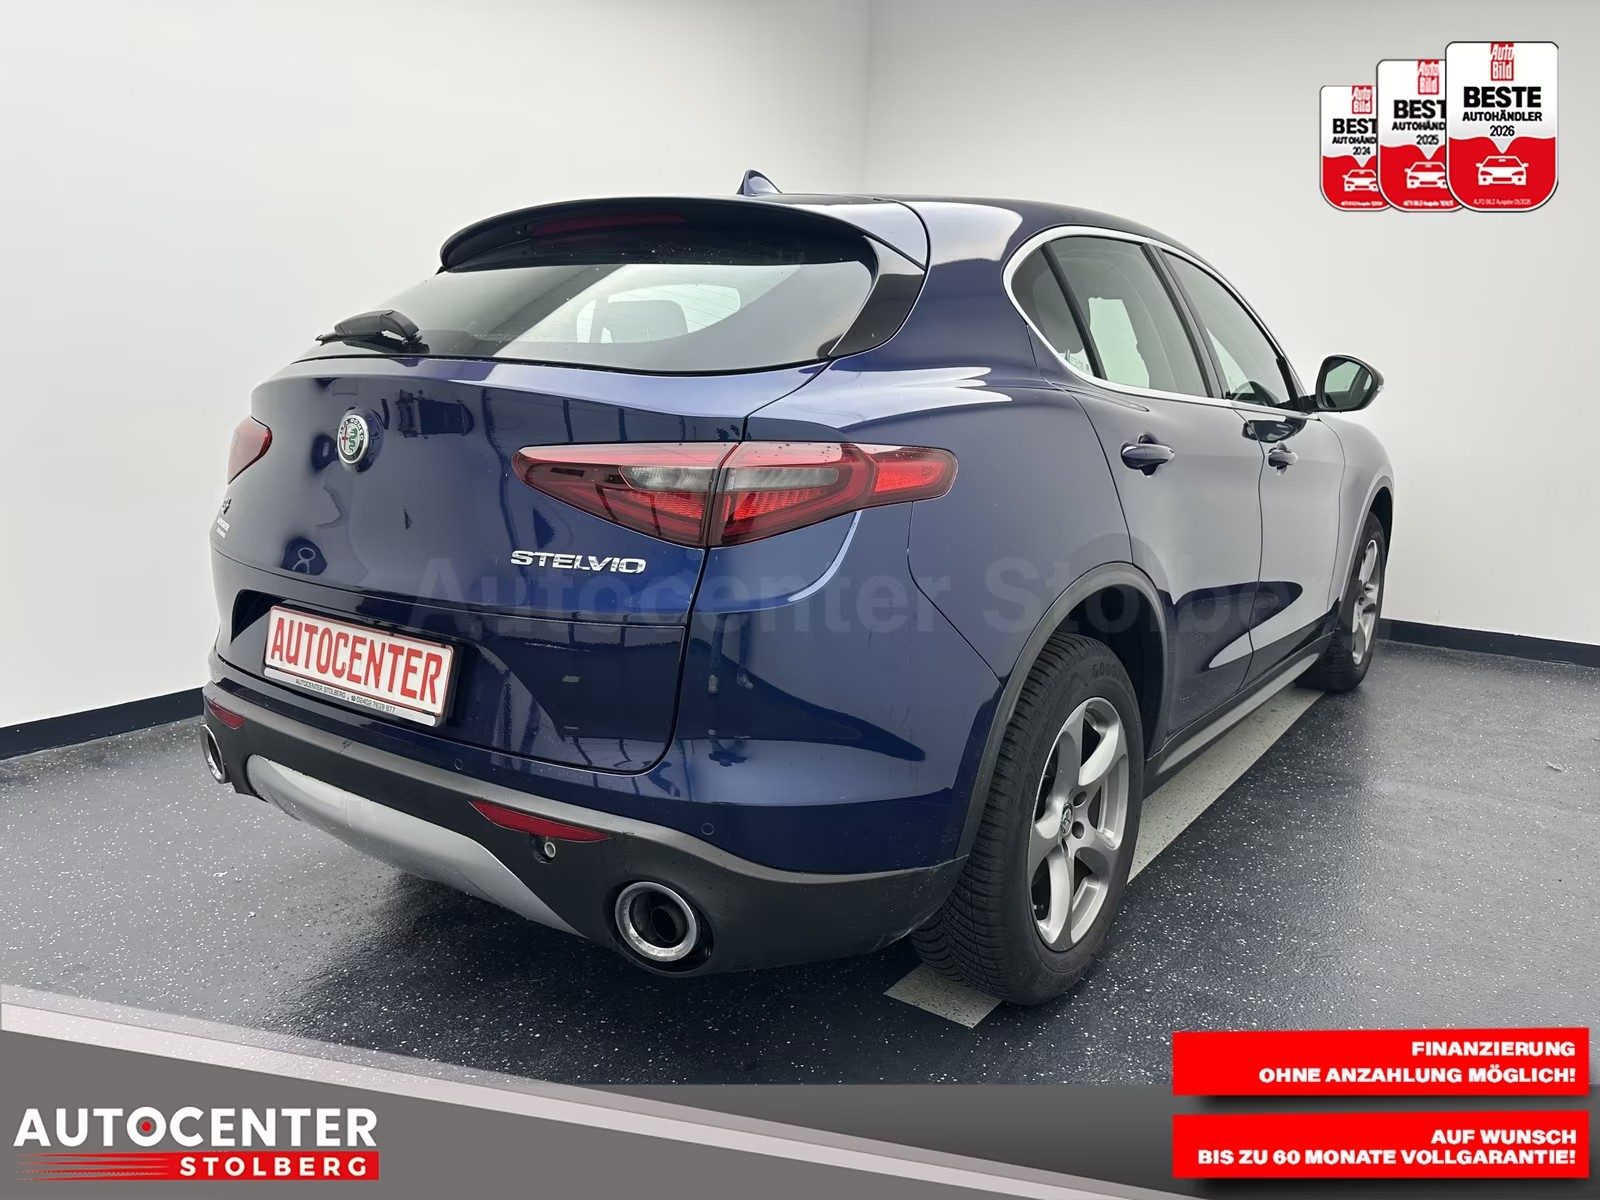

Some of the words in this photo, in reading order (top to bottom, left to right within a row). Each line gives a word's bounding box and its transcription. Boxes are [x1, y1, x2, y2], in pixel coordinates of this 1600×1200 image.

[510, 550, 646, 573] STELVIO
[270, 616, 443, 704] AUTOCENTER
[296, 678, 323, 693] AUTOCENTER
[324, 686, 346, 698] STOLBERG
